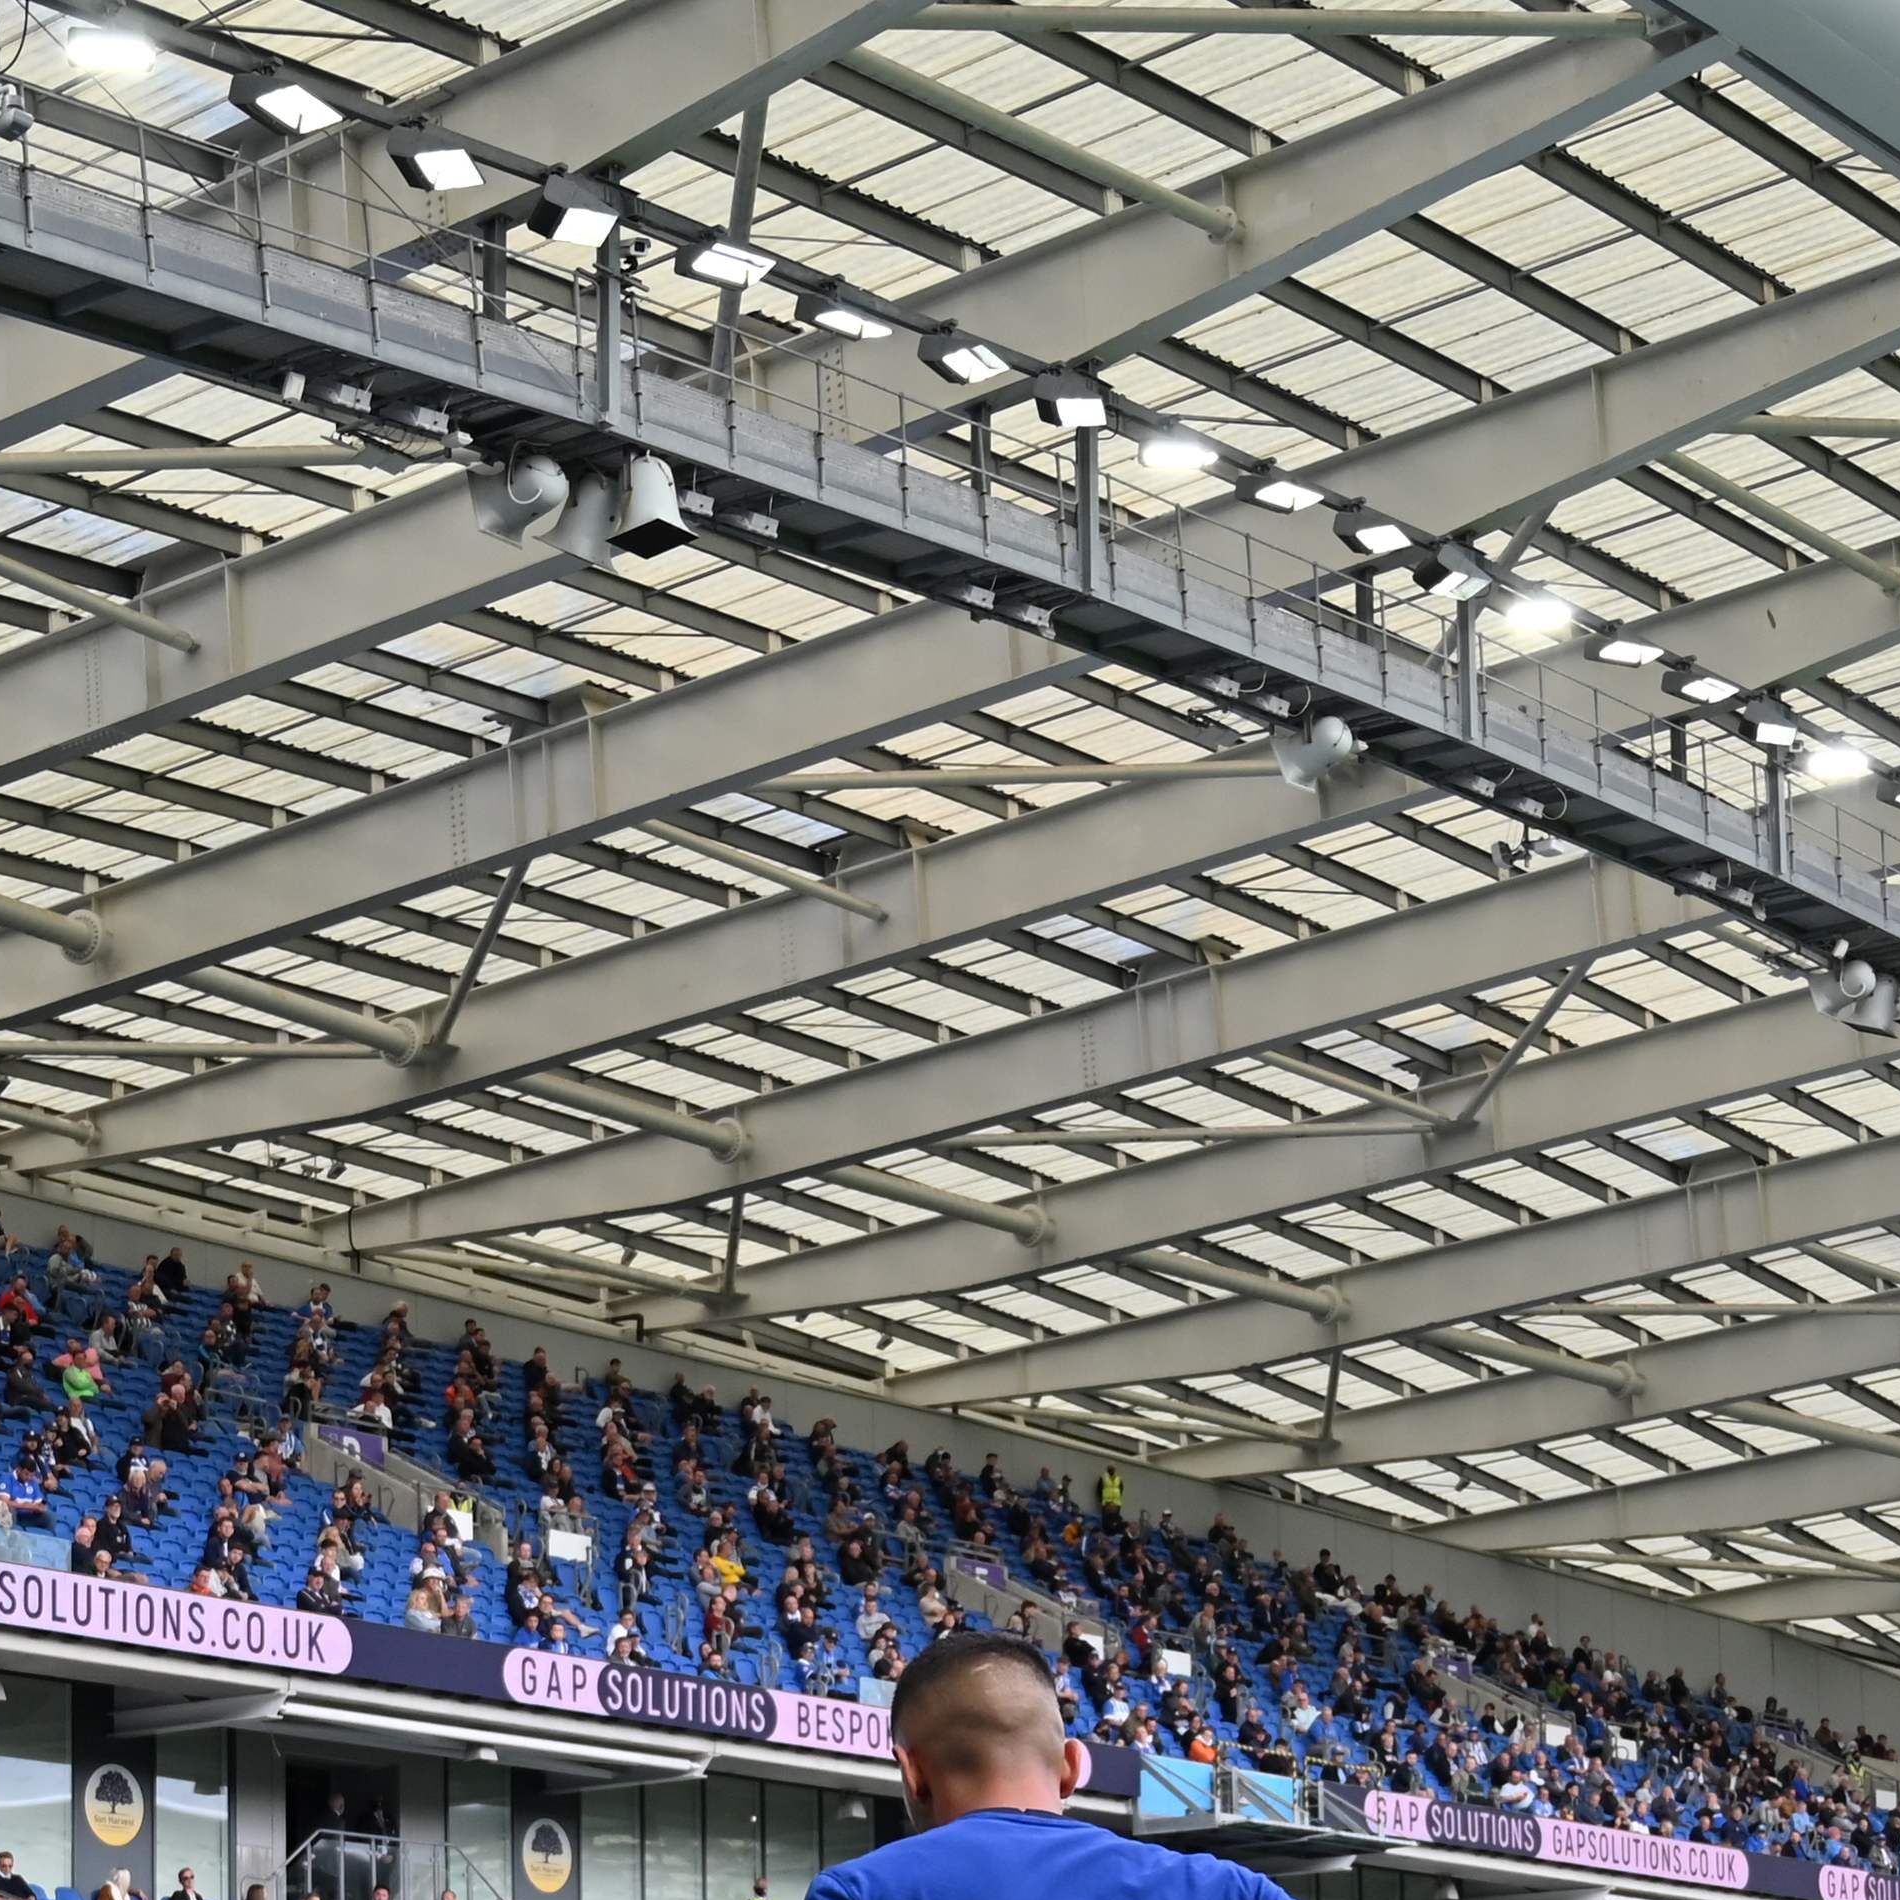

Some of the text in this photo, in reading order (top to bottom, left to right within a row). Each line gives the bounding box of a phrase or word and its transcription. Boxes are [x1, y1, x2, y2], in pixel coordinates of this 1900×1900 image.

[521, 1655, 587, 1703] GAP
[607, 1668, 766, 1733] SOLUTIONS
[1431, 1804, 1535, 1852] SOLUTIONS
[1552, 1825, 1737, 1883] GAPSOLUTIONS.CO.UK
[1827, 1871, 1860, 1900] GAP
